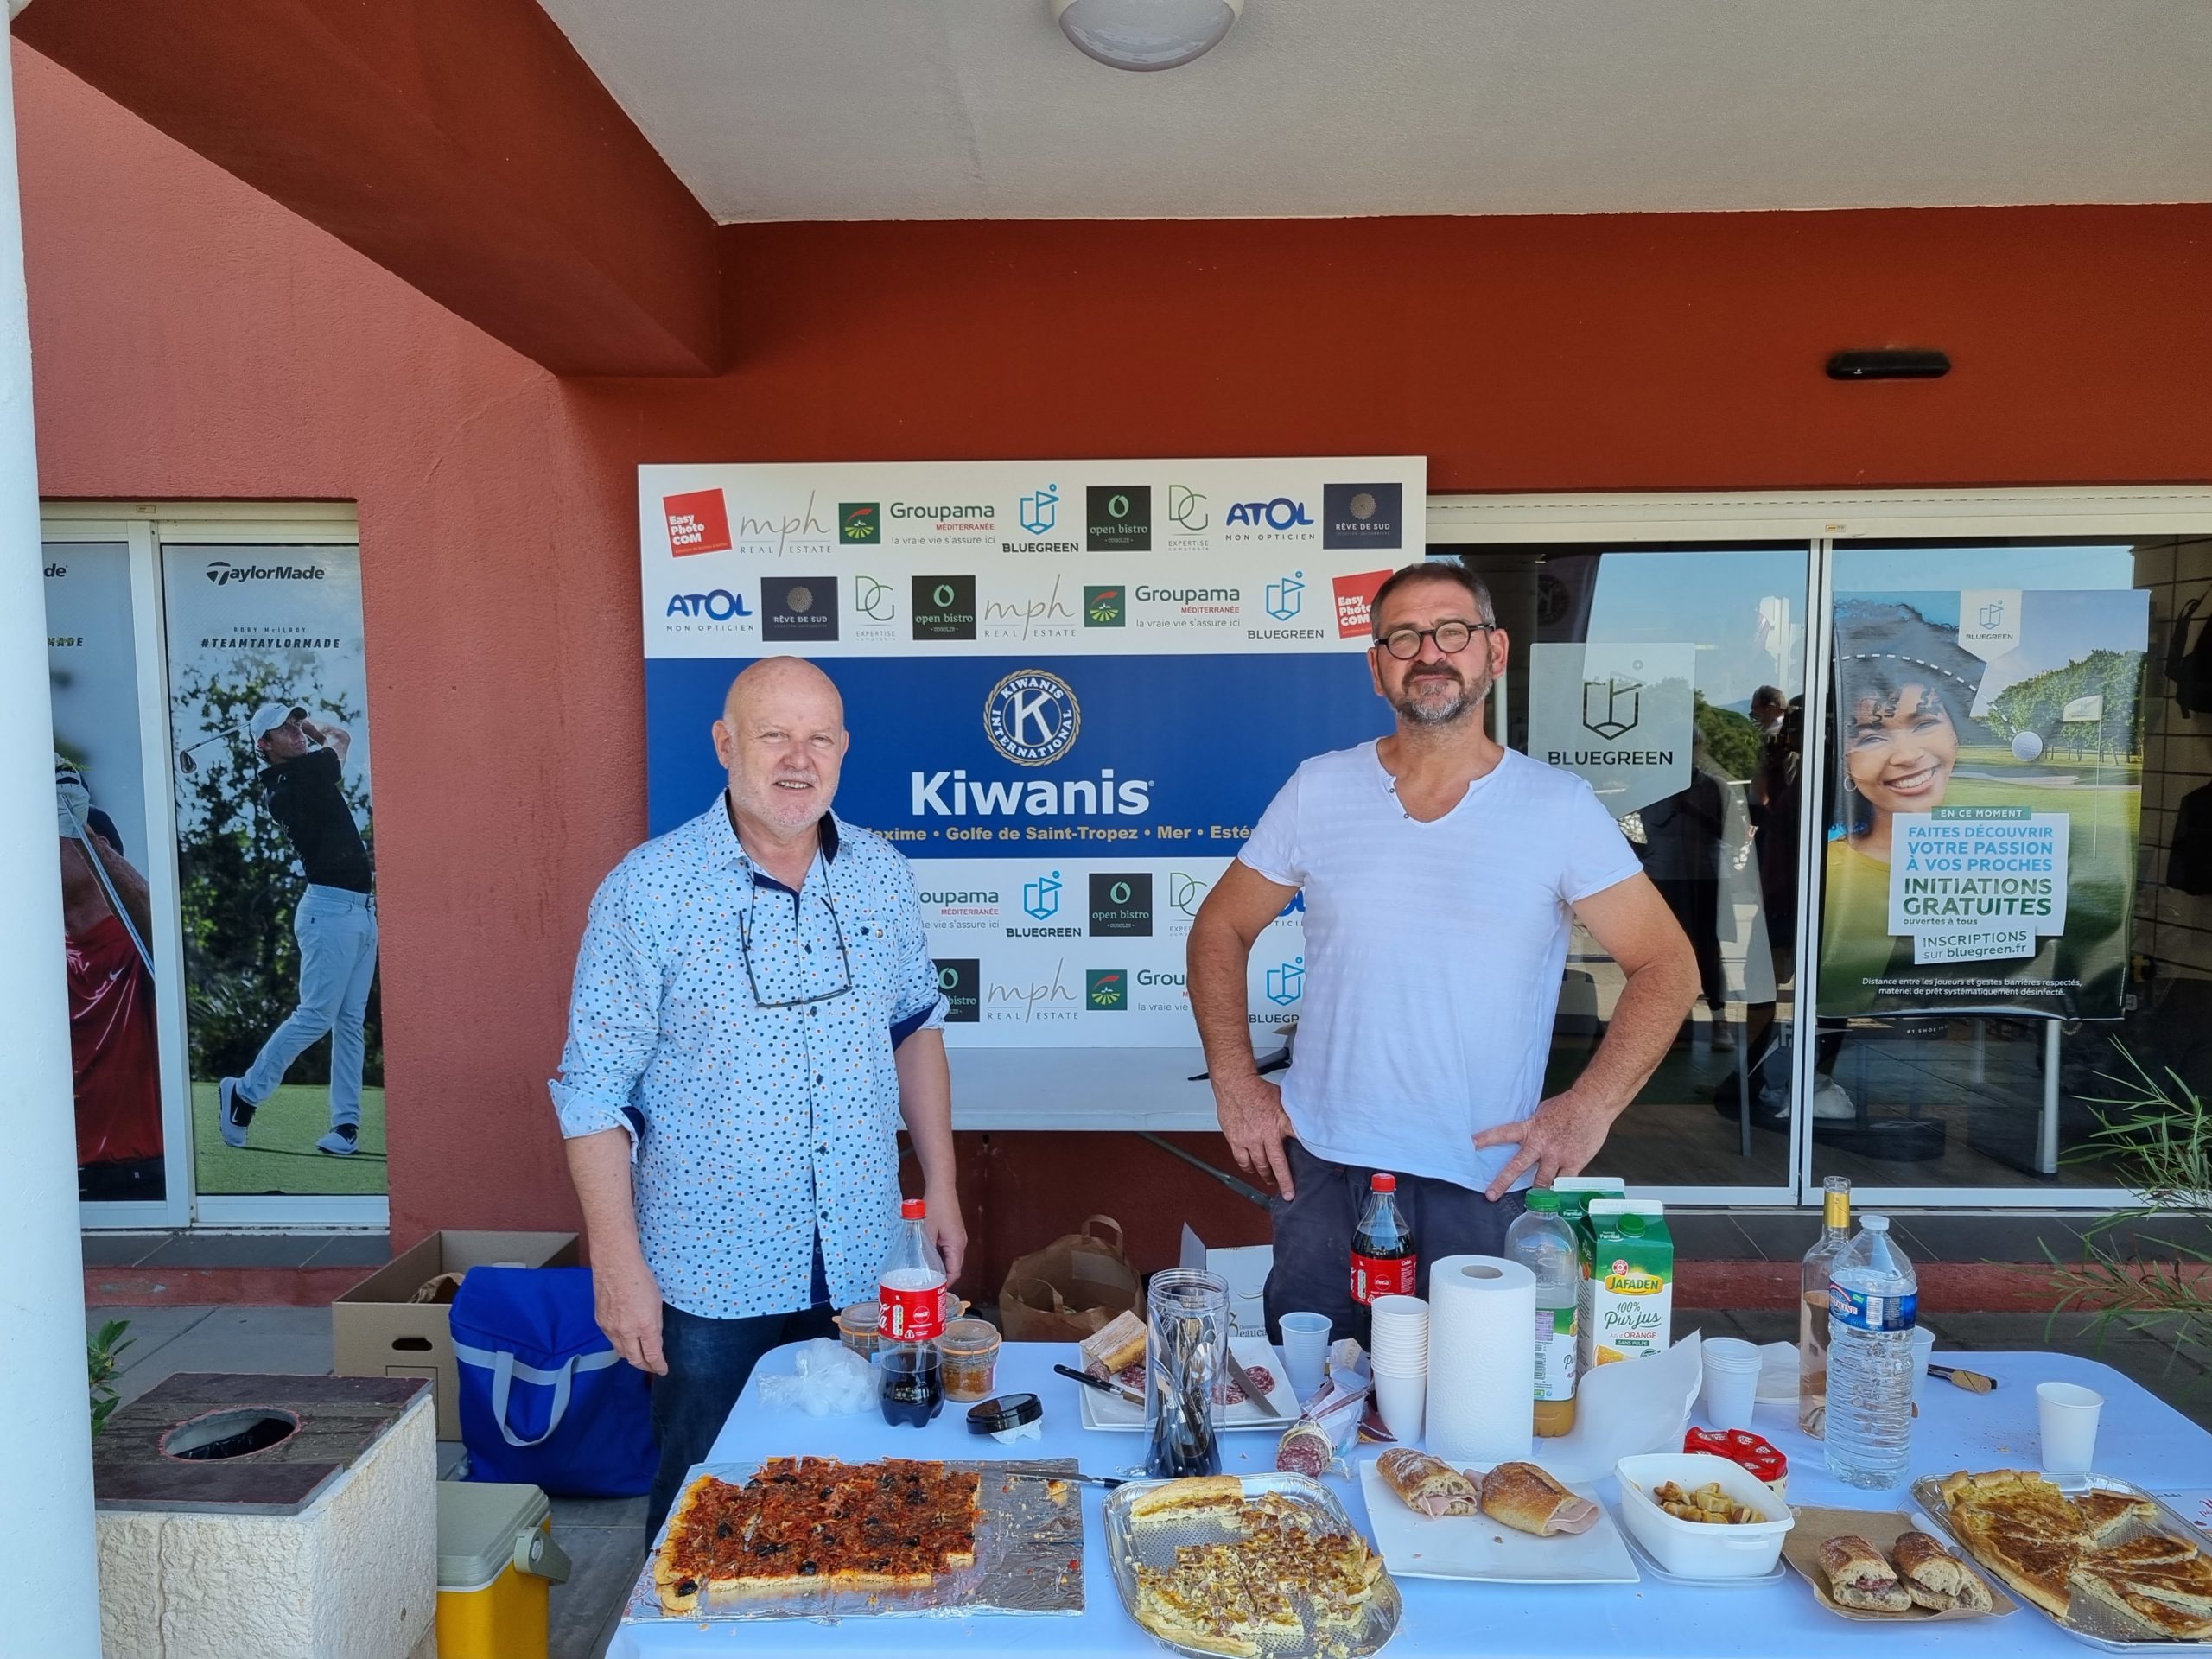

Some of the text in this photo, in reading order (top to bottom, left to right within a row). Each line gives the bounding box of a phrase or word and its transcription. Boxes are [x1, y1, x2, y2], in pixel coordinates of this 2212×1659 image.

[890, 502, 995, 522] Groupama
[1226, 498, 1314, 531] ATOL
[669, 515, 695, 525] Easy
[741, 489, 830, 557] mph
[1335, 522, 1357, 531] RÊVE
[671, 523, 705, 536] Photo
[1090, 524, 1148, 536] open bistro
[892, 535, 995, 545] la vraie vie s'assure ici
[790, 545, 832, 554] ESTATE
[1002, 543, 1079, 553] BLUEGREEN
[207, 562, 325, 586] TaylorMade
[1135, 585, 1240, 605] Groupama
[1338, 595, 1363, 607] Easy
[666, 589, 753, 621] ATOL
[984, 574, 1076, 640] mph
[773, 614, 795, 623] RÊVE
[915, 613, 974, 625] open bistro
[1136, 619, 1146, 627] la
[1189, 618, 1227, 627] s'assure
[1230, 618, 1241, 626] ici
[1247, 629, 1325, 639] BLUEGREEN
[201, 638, 340, 649] #TEAMTAYLORMADE
[1001, 677, 1064, 699] KIWANIS
[991, 709, 1072, 758] INTERNATIONAL
[1548, 751, 1673, 766] BLUEGREEN
[912, 769, 1150, 816] Kiwanis
[874, 828, 927, 841] axime
[946, 827, 993, 841] Golfe
[998, 827, 1020, 841] de
[1026, 826, 1138, 842] Saint-Tropez
[1157, 826, 1192, 839] Mer
[1909, 824, 2053, 838] FAITES DÉCOUVRIR
[1908, 842, 2053, 855] VOTRE PASSION
[1906, 855, 2053, 871] À VOS PROCHES
[1904, 878, 2053, 895] INITIATIONS
[919, 891, 999, 907] oupama
[1903, 897, 2052, 916] GRATUITES
[1092, 909, 1150, 922] open bistro
[1948, 917, 1954, 925] à
[933, 920, 947, 929] vie
[949, 919, 987, 929] s'assure
[989, 919, 1000, 929] ici
[1006, 927, 1082, 938] BLUEGREEN
[1923, 931, 2027, 948] INSCRIPTIONS
[1947, 944, 2026, 959] bluegreen.fr
[1137, 969, 1185, 986] Grou
[1934, 978, 1964, 987] joueurs
[2042, 978, 2082, 988] respectés,
[988, 957, 1078, 1023] mph
[1925, 987, 1942, 996] prêt
[1943, 988, 2018, 997] systématiquement
[2020, 988, 2065, 996] désinfecté.
[1138, 1002, 1188, 1012] la vraie vie
[1249, 1014, 1300, 1024] BLUEGR
[1611, 1277, 1658, 1290] JAFADEN
[1617, 1301, 1641, 1313] 100%
[1605, 1311, 1662, 1329] Pur jus
